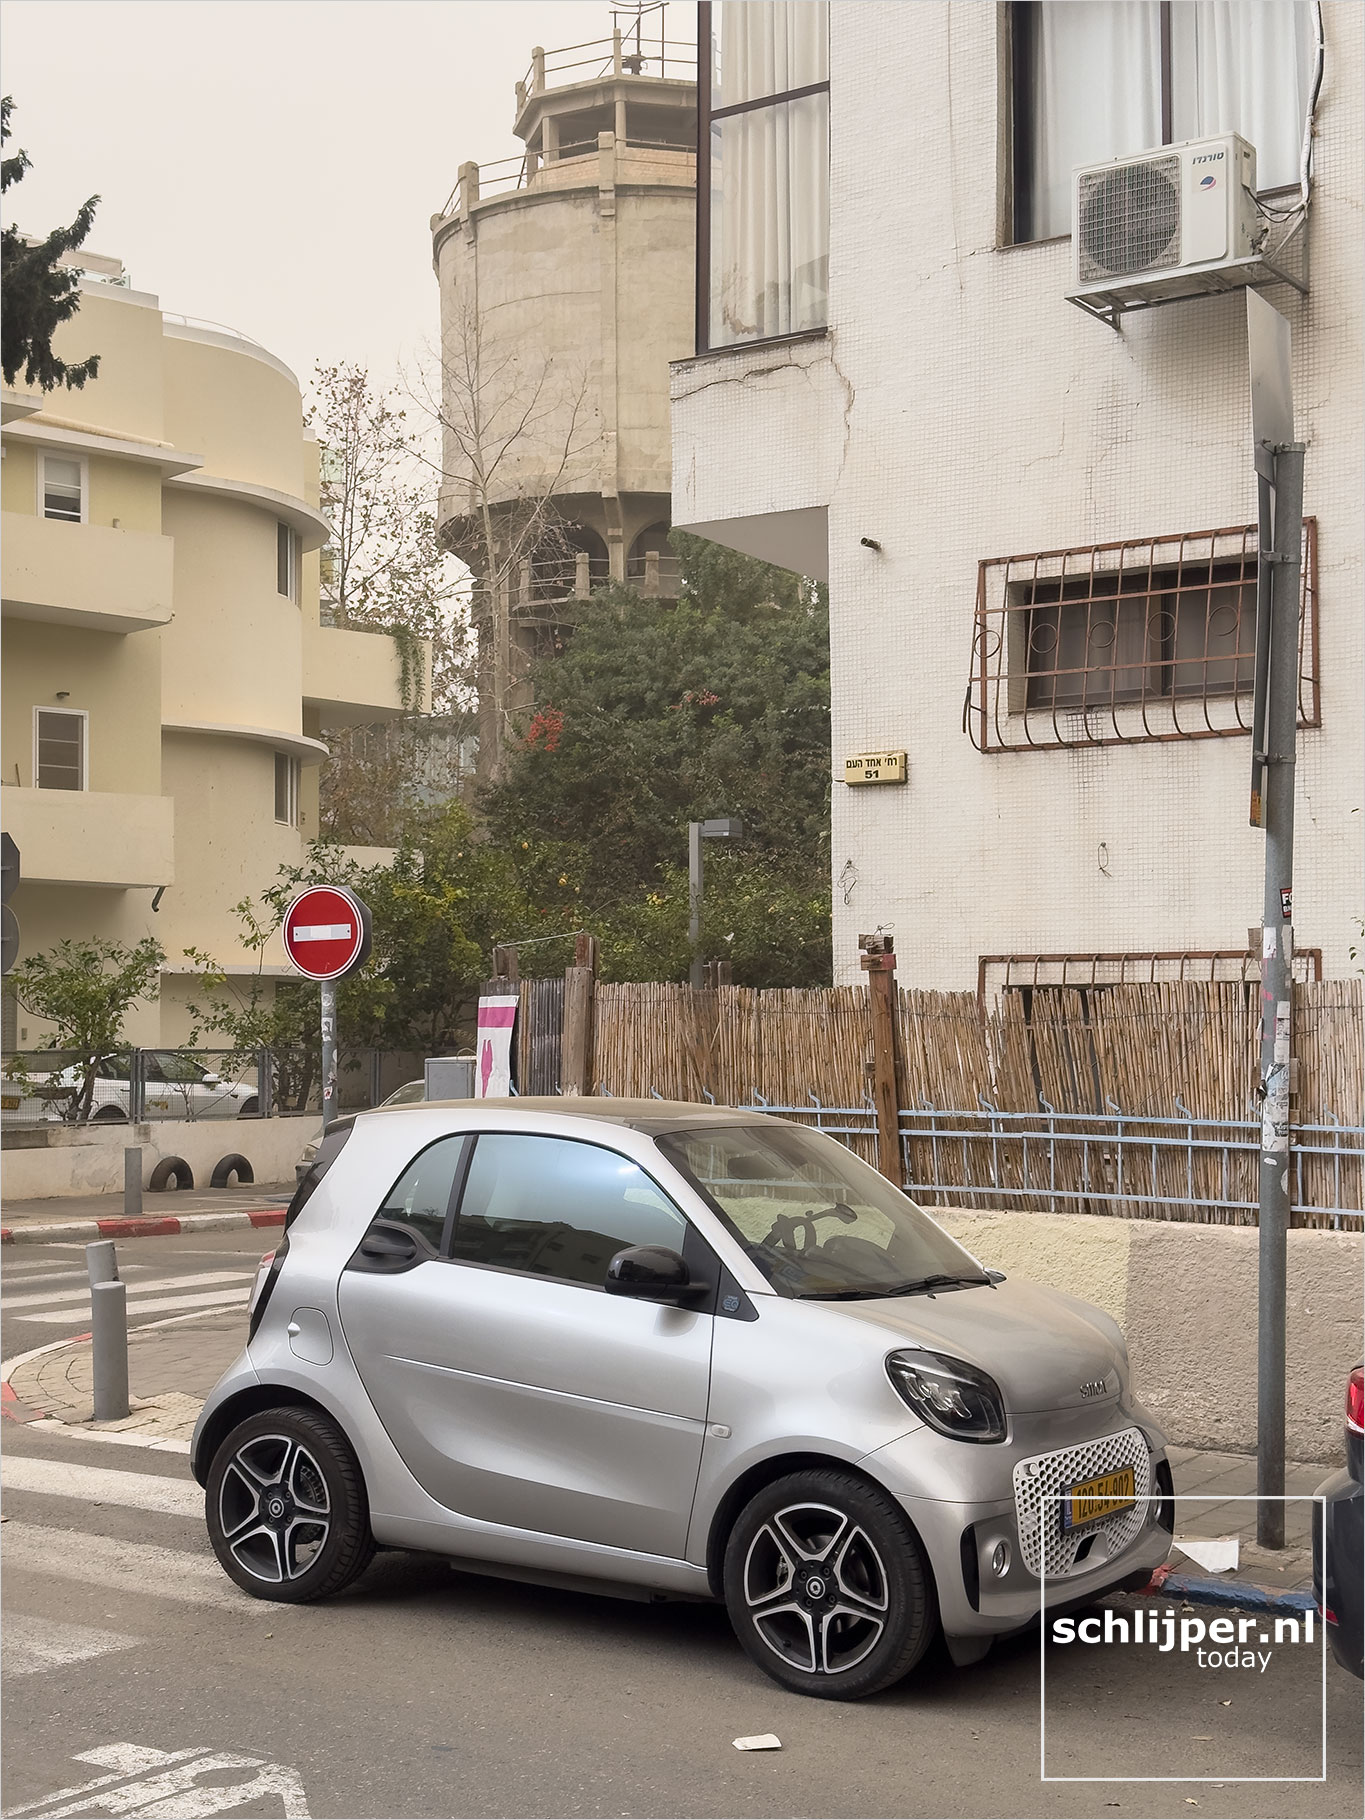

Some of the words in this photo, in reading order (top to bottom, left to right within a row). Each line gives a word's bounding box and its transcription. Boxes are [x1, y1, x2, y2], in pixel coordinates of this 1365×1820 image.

[1192, 152, 1224, 165] טורנדו
[846, 759, 863, 769] העם
[865, 758, 881, 768] אחד
[865, 769, 879, 779] 51
